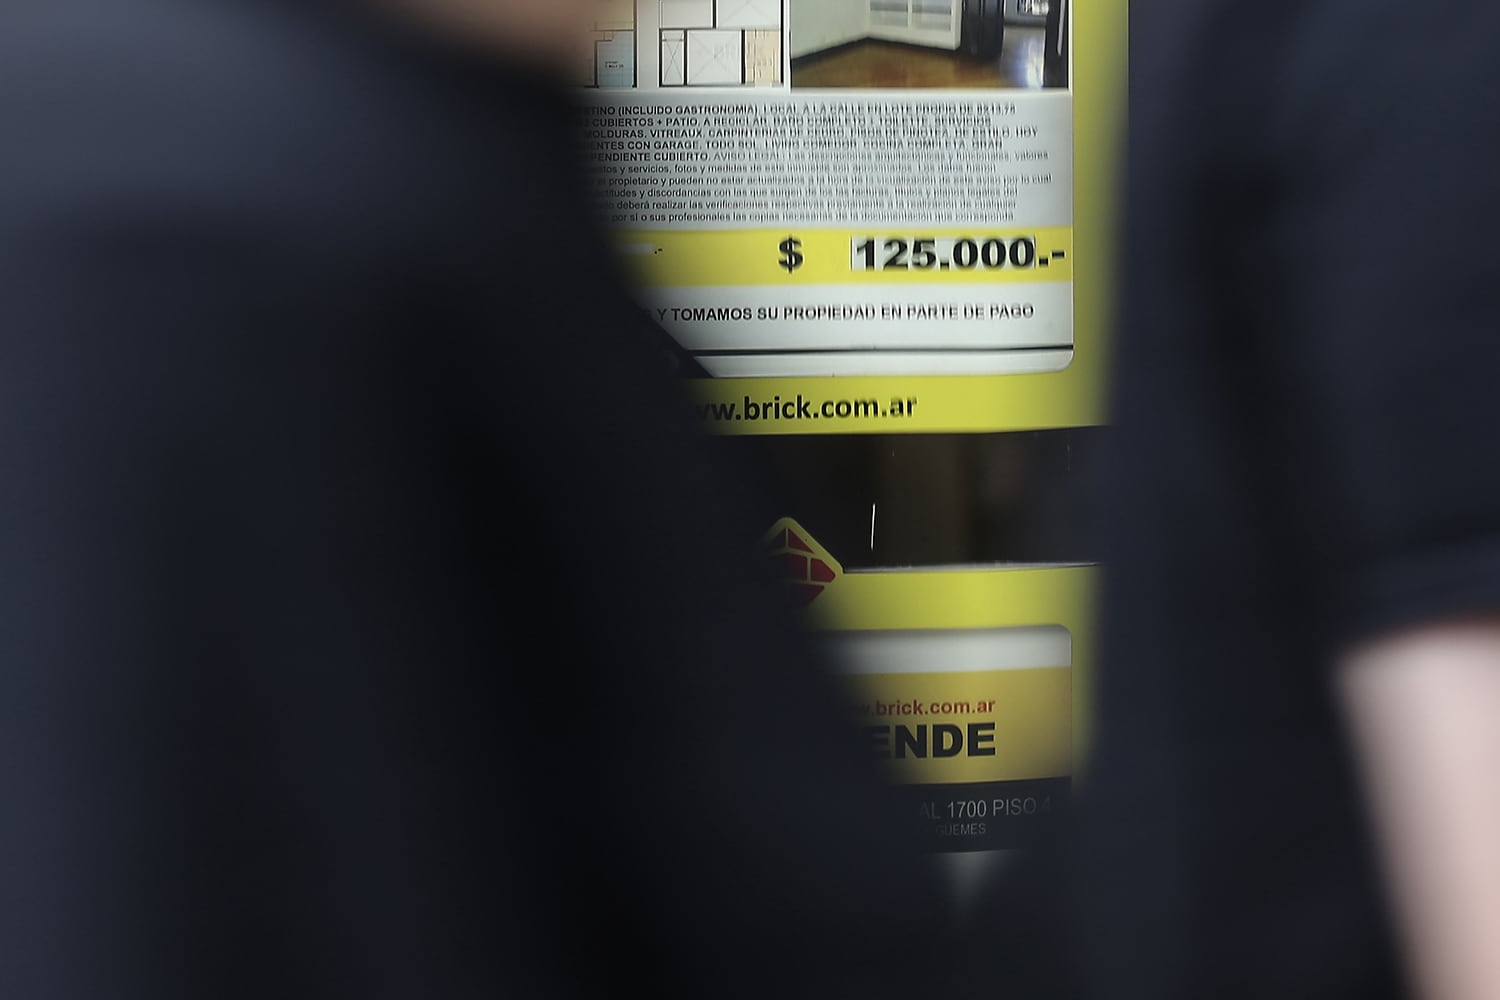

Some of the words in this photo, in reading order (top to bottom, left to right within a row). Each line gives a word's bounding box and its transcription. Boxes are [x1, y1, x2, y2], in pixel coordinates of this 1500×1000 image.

[592, 129, 647, 139] OLDURAS.
[628, 141, 650, 150] CON
[609, 176, 658, 187] propietario
[778, 236, 803, 274] $
[855, 237, 1065, 270] 125.000.-
[657, 307, 667, 321] Y
[671, 307, 752, 322] TOMAMOS
[758, 306, 778, 321] SU
[784, 306, 875, 321] PROPIEDAD
[882, 305, 901, 320] EN
[907, 305, 958, 320] PARTE
[964, 304, 984, 320] DE
[990, 304, 1035, 319] PAGO
[871, 722, 997, 760] ENDE
[948, 800, 987, 819] 1700
[993, 798, 1036, 818] PISO
